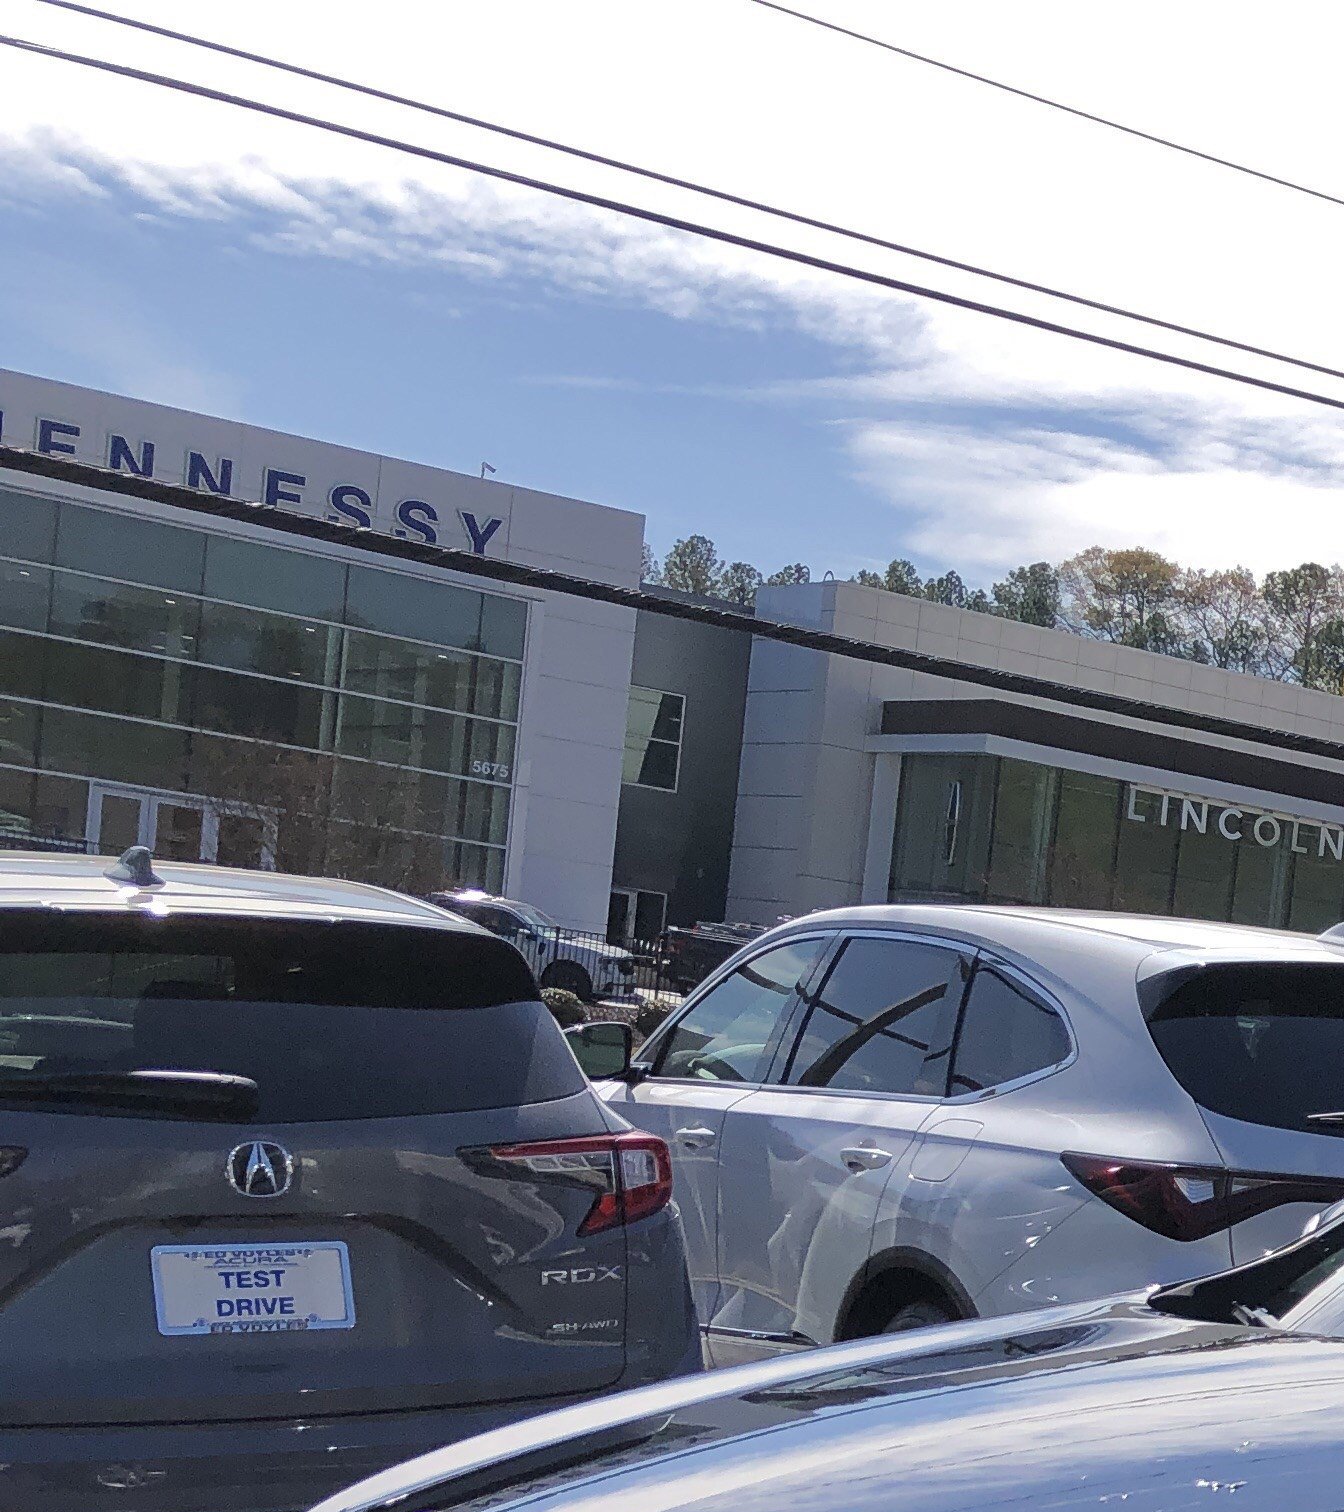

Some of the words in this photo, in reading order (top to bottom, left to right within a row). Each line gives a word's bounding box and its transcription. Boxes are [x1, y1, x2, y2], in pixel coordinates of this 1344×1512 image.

[0, 411, 503, 555] ENNESSY
[472, 760, 509, 778] 5675
[1127, 783, 1344, 861] LINCOLN
[213, 1256, 289, 1266] ACURA
[217, 1269, 286, 1289] TEST
[541, 1265, 622, 1286] RDX
[216, 1296, 296, 1317] DRIVE
